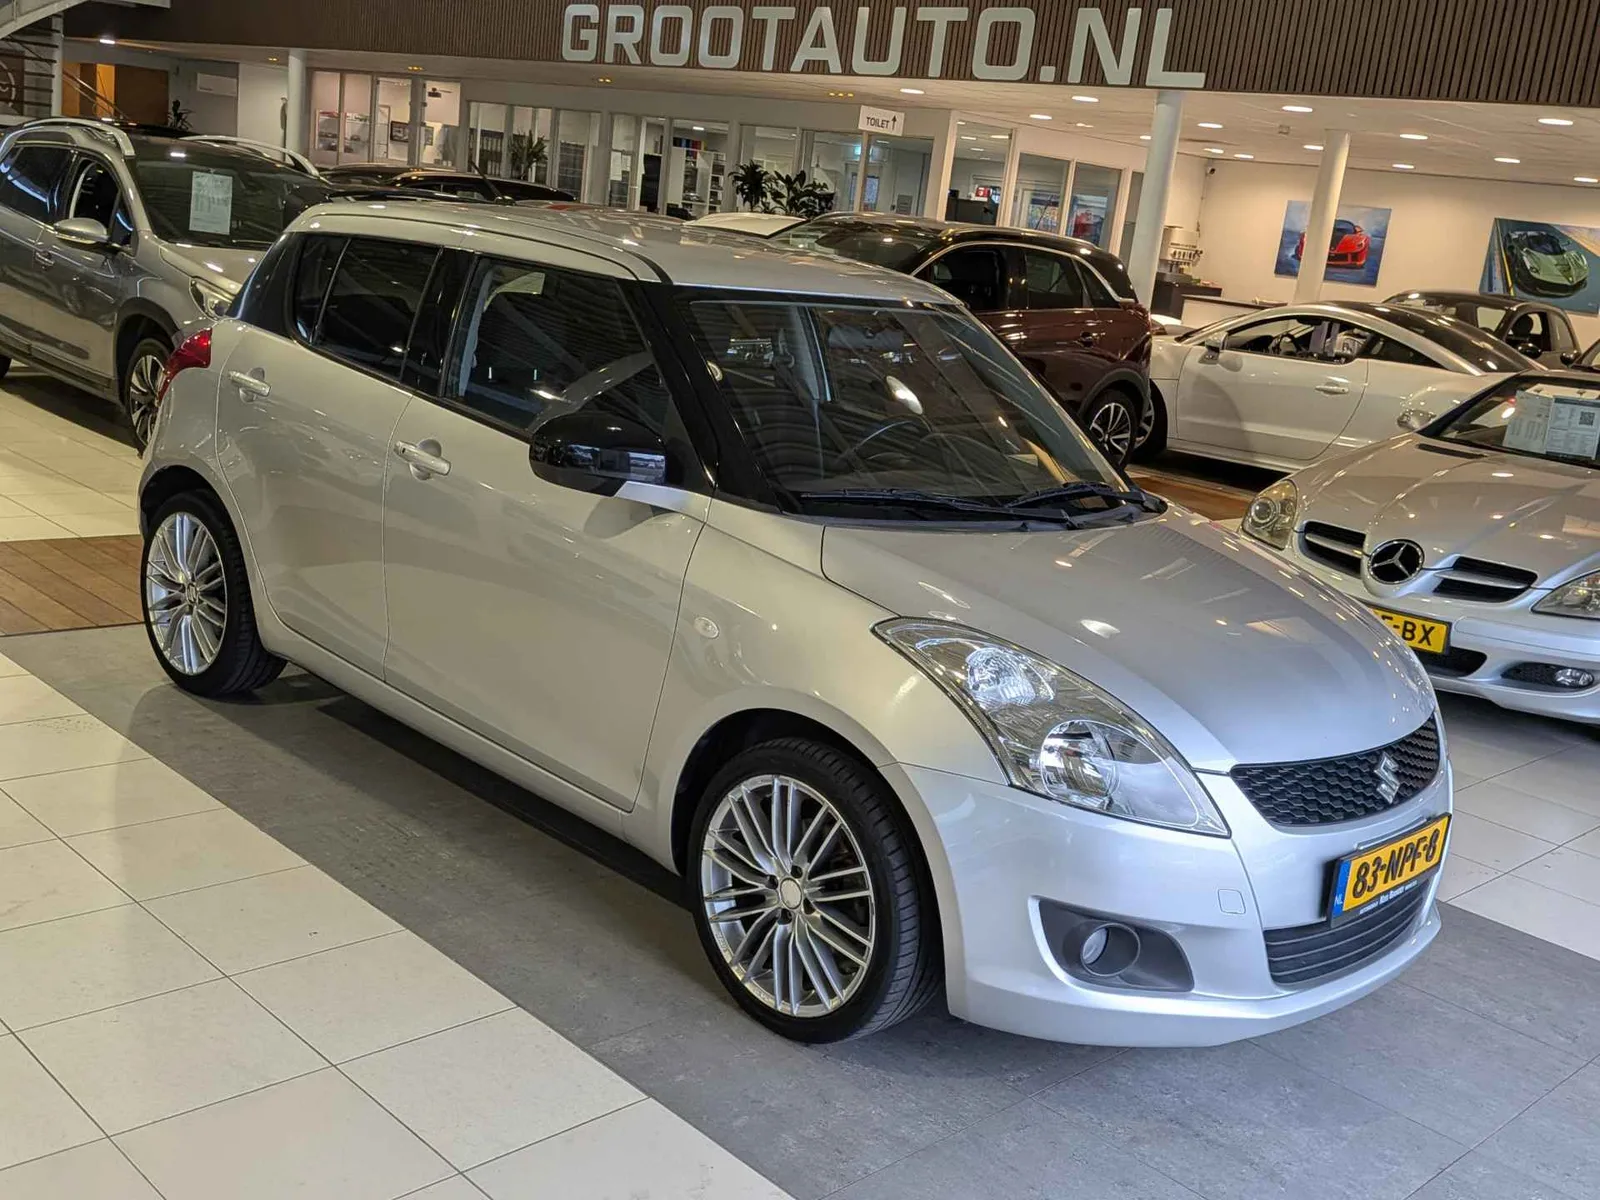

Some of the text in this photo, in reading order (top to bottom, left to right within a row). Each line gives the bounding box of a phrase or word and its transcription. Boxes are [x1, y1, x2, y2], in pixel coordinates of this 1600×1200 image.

[562, 4, 1206, 88] GROOTAUTO.NL
[866, 116, 890, 129] TOILET
[1381, 615, 1436, 646] -BX
[1352, 828, 1440, 899] 83-NPF-8
[1334, 893, 1344, 907] NL
